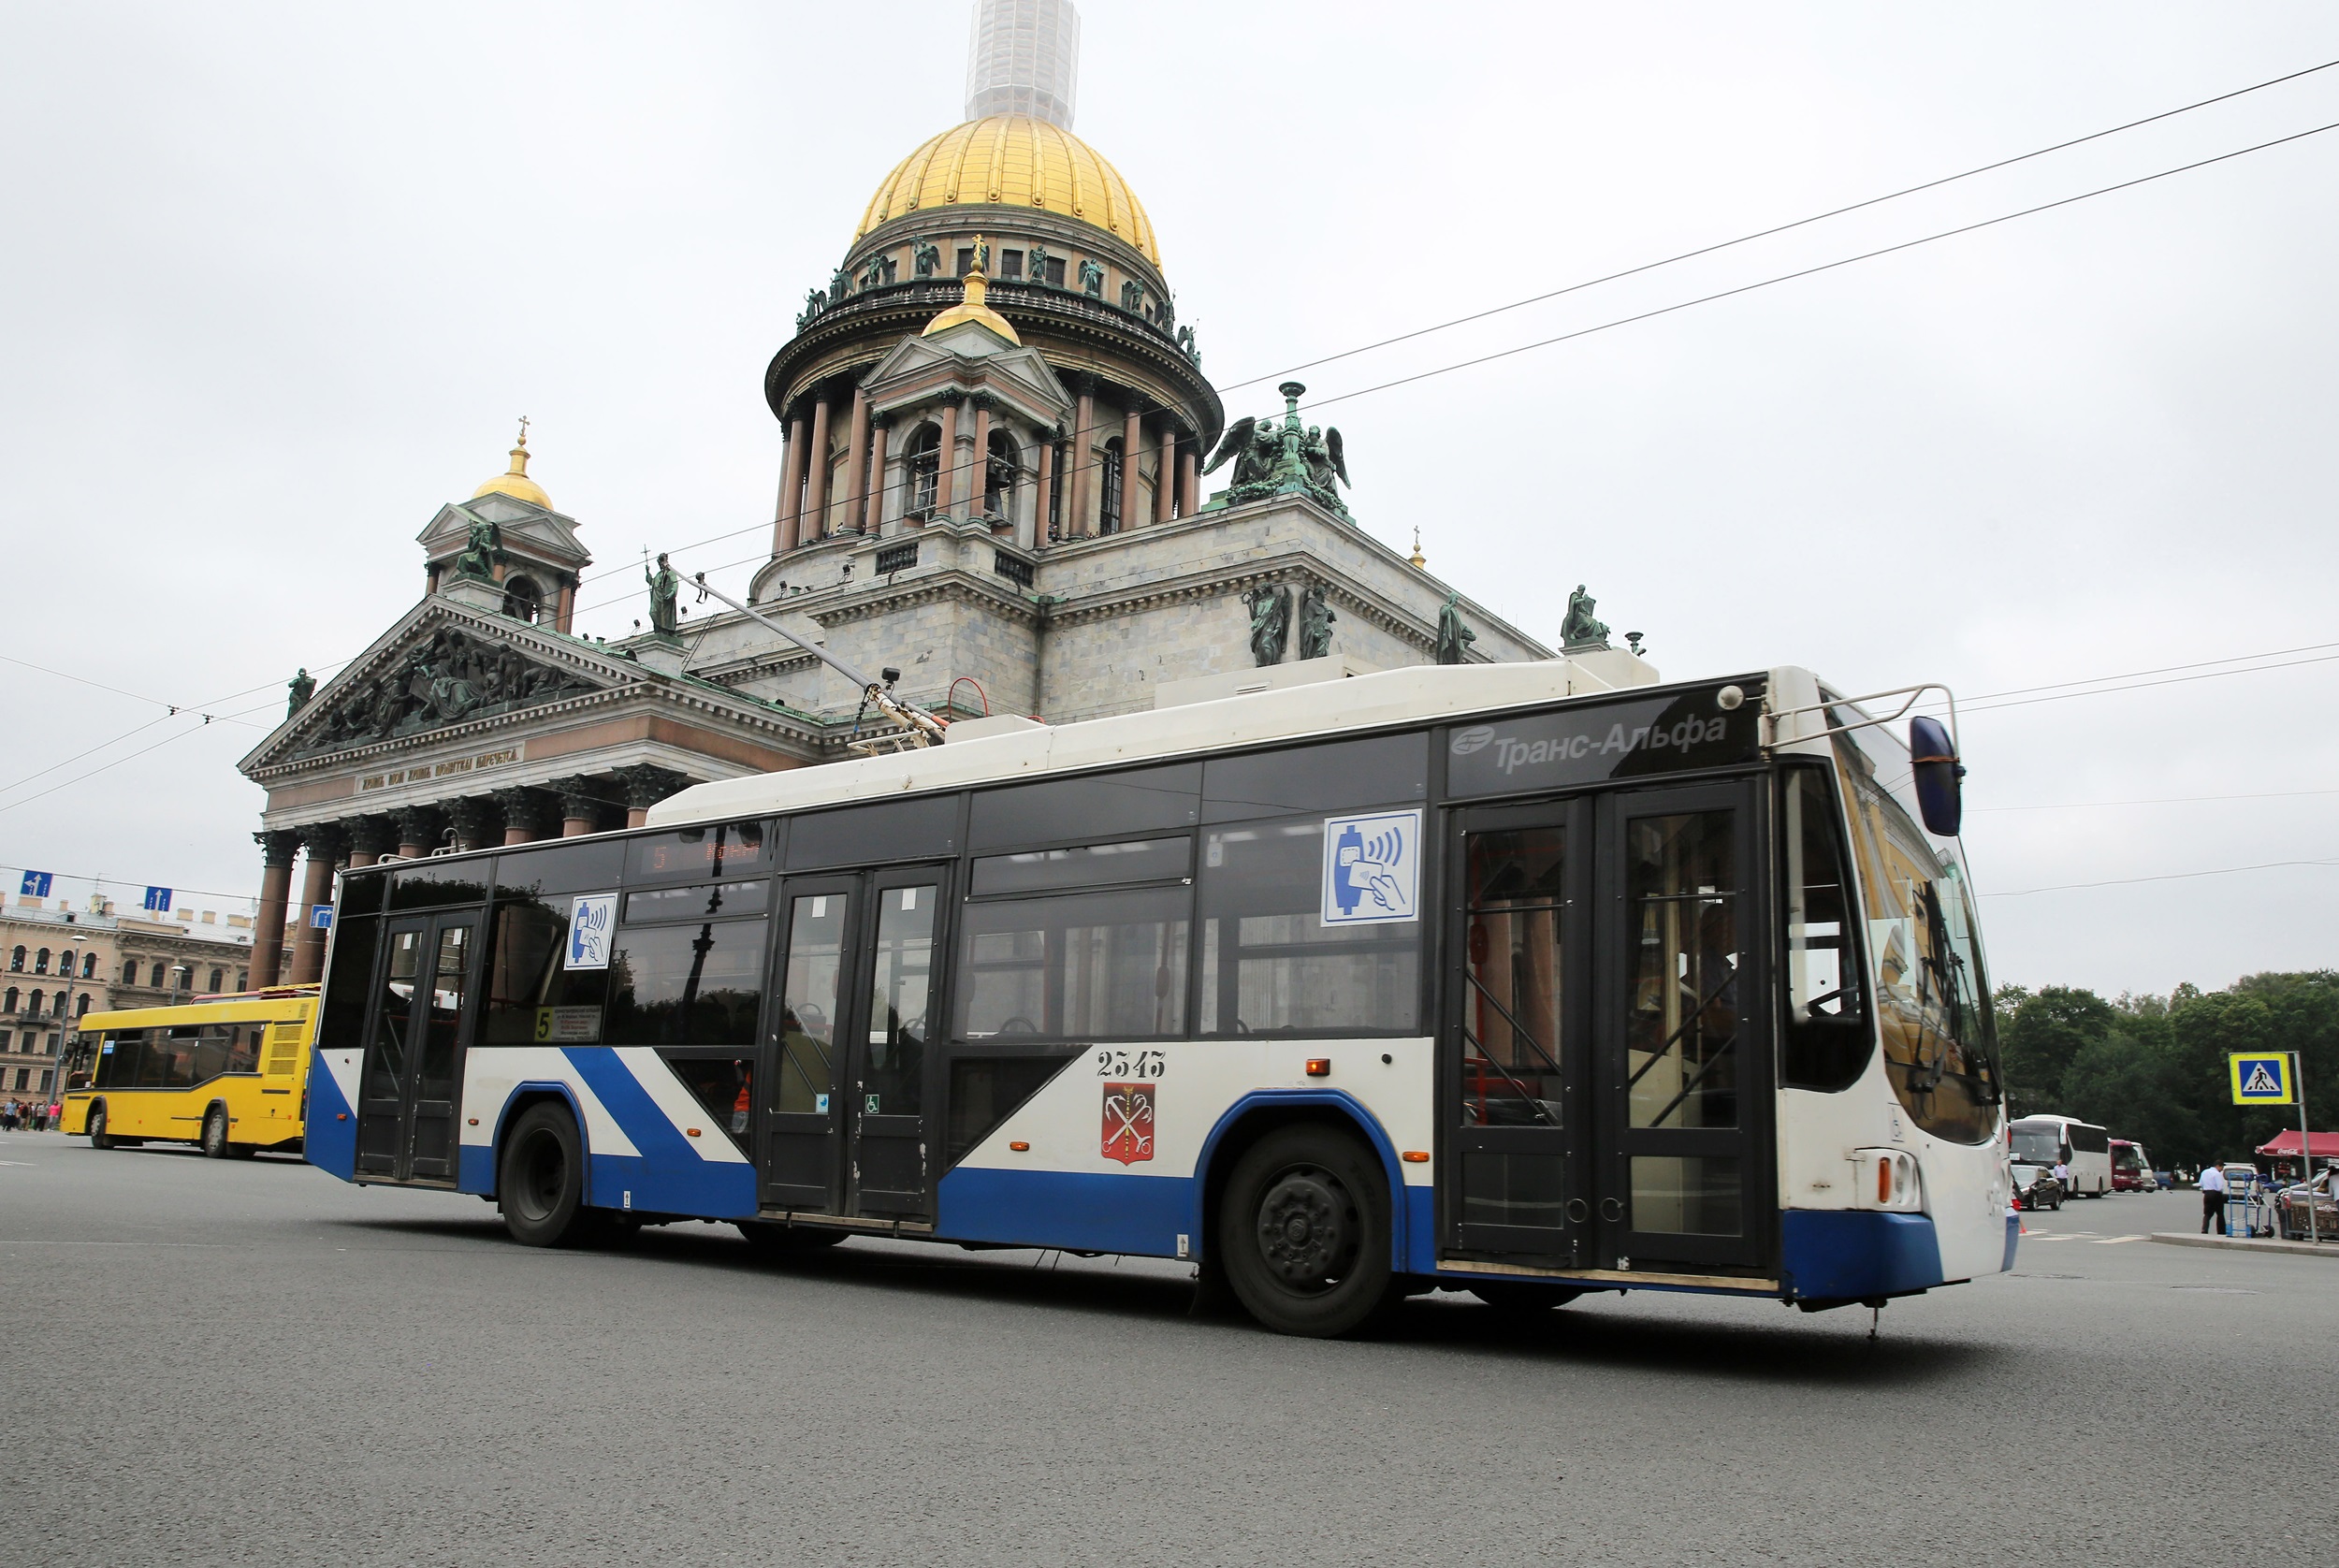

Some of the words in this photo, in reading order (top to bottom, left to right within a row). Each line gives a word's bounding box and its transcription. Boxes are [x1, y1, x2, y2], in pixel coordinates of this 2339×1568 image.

[1494, 713, 1727, 776] Транс-Альфа
[537, 1011, 550, 1039] 5
[1097, 1051, 1167, 1079] 2545
